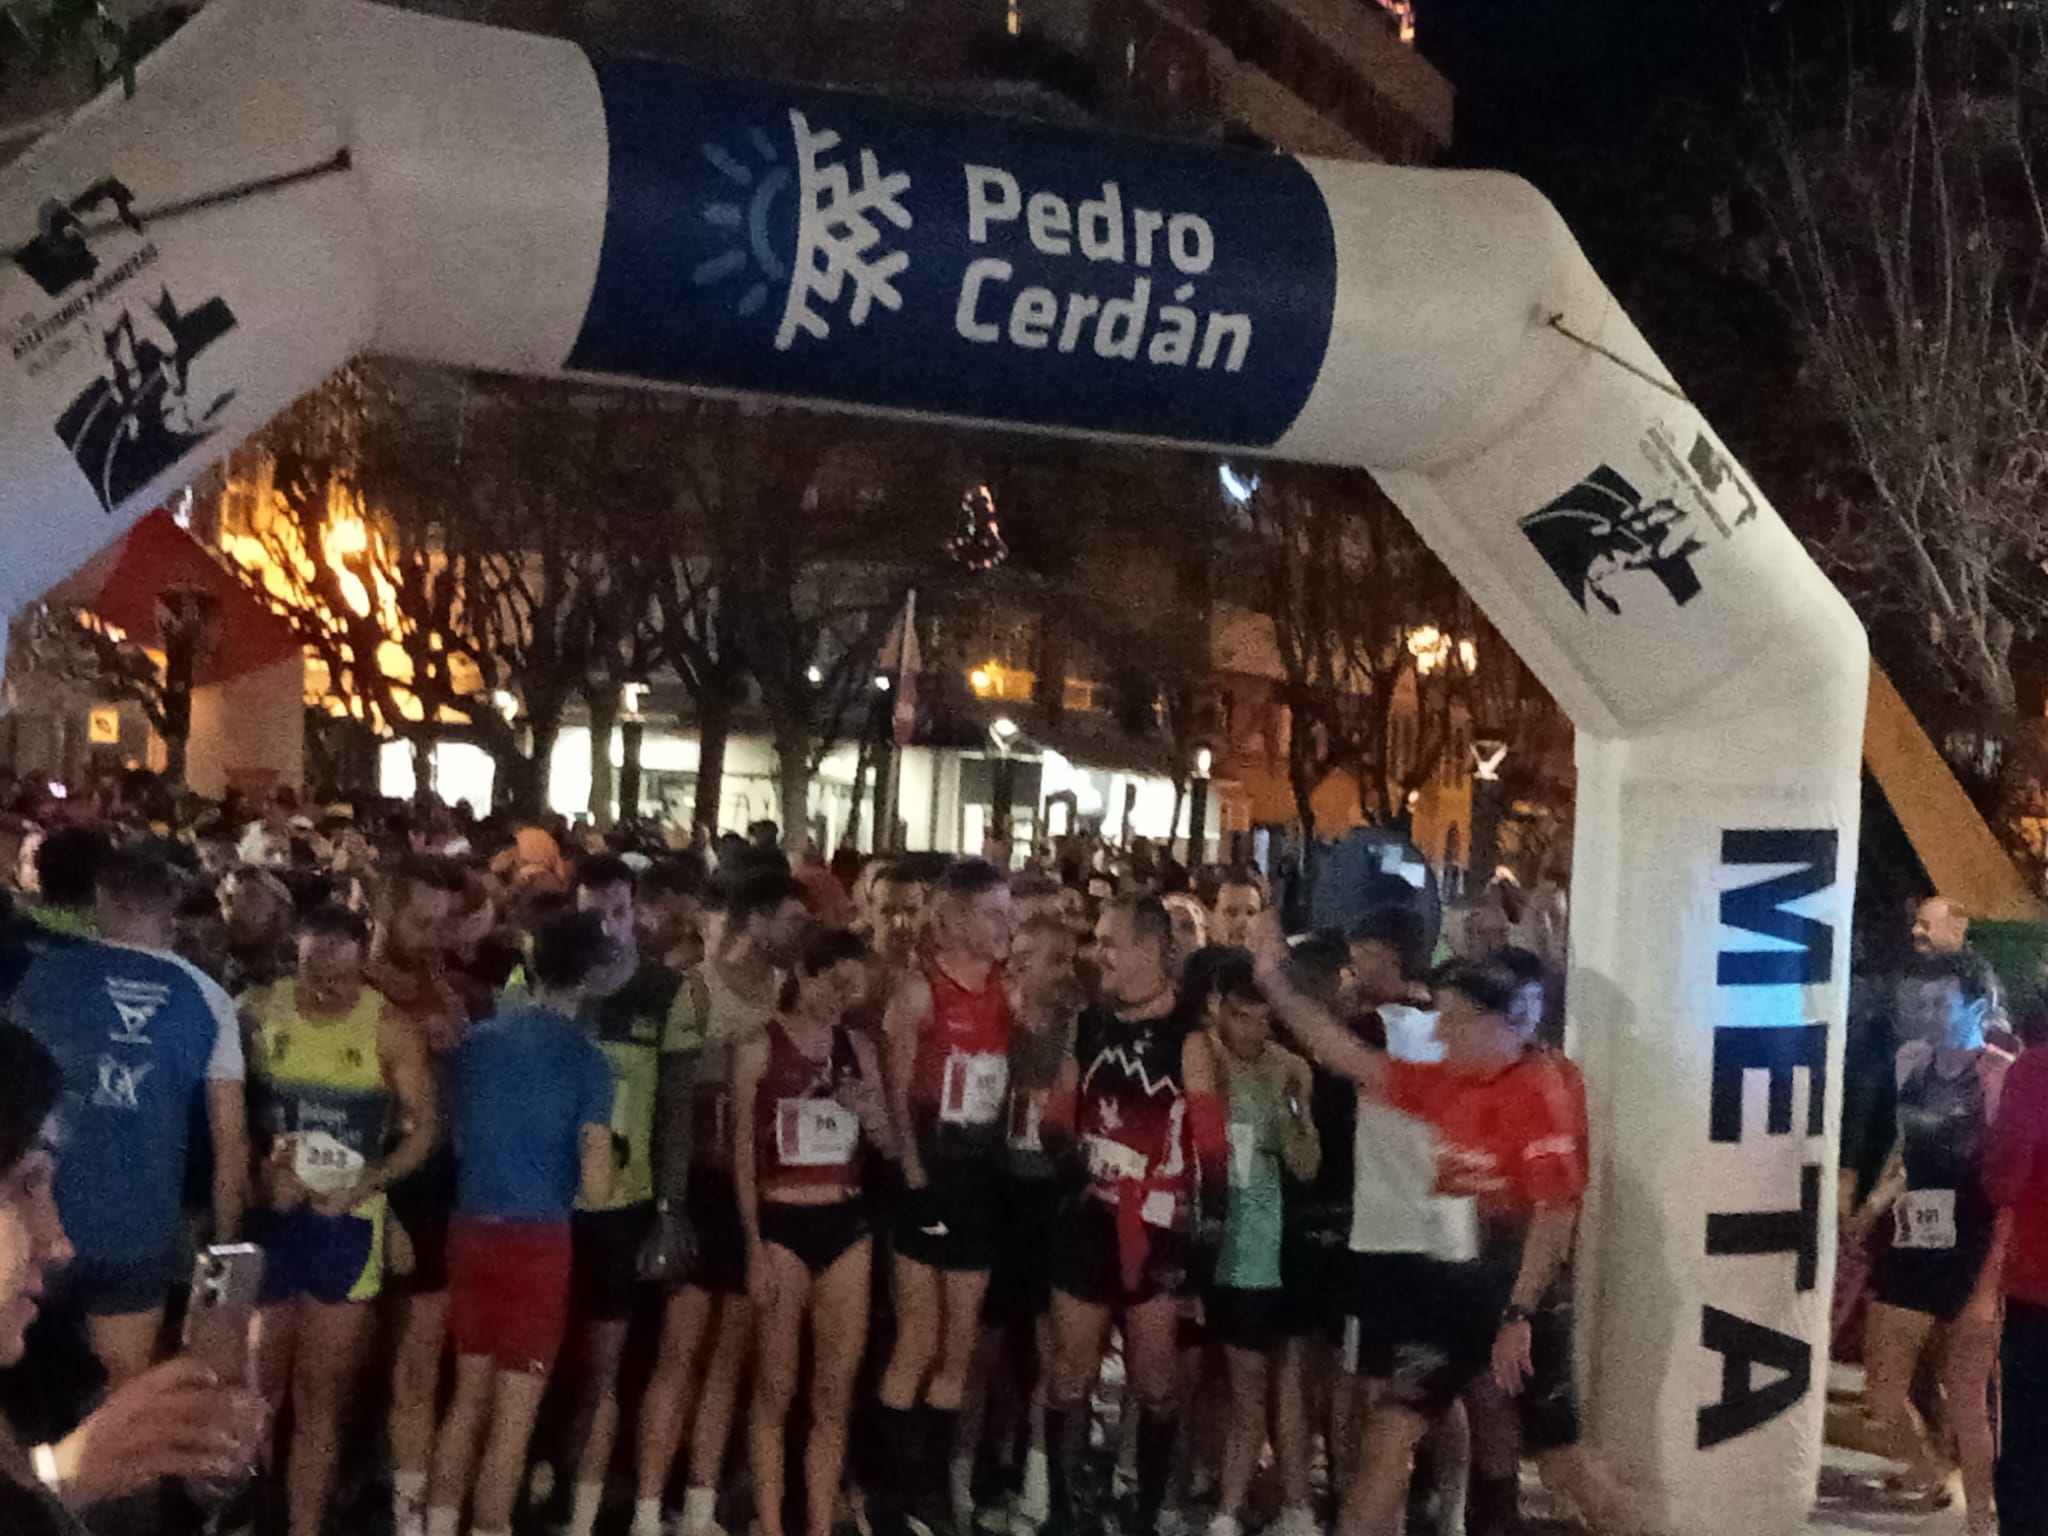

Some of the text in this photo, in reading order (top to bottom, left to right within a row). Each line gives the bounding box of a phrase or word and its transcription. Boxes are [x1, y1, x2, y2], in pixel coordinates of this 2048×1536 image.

[964, 163, 1214, 274] Pedro
[956, 257, 1251, 372] Cerdán
[1697, 828, 1840, 1450] META
